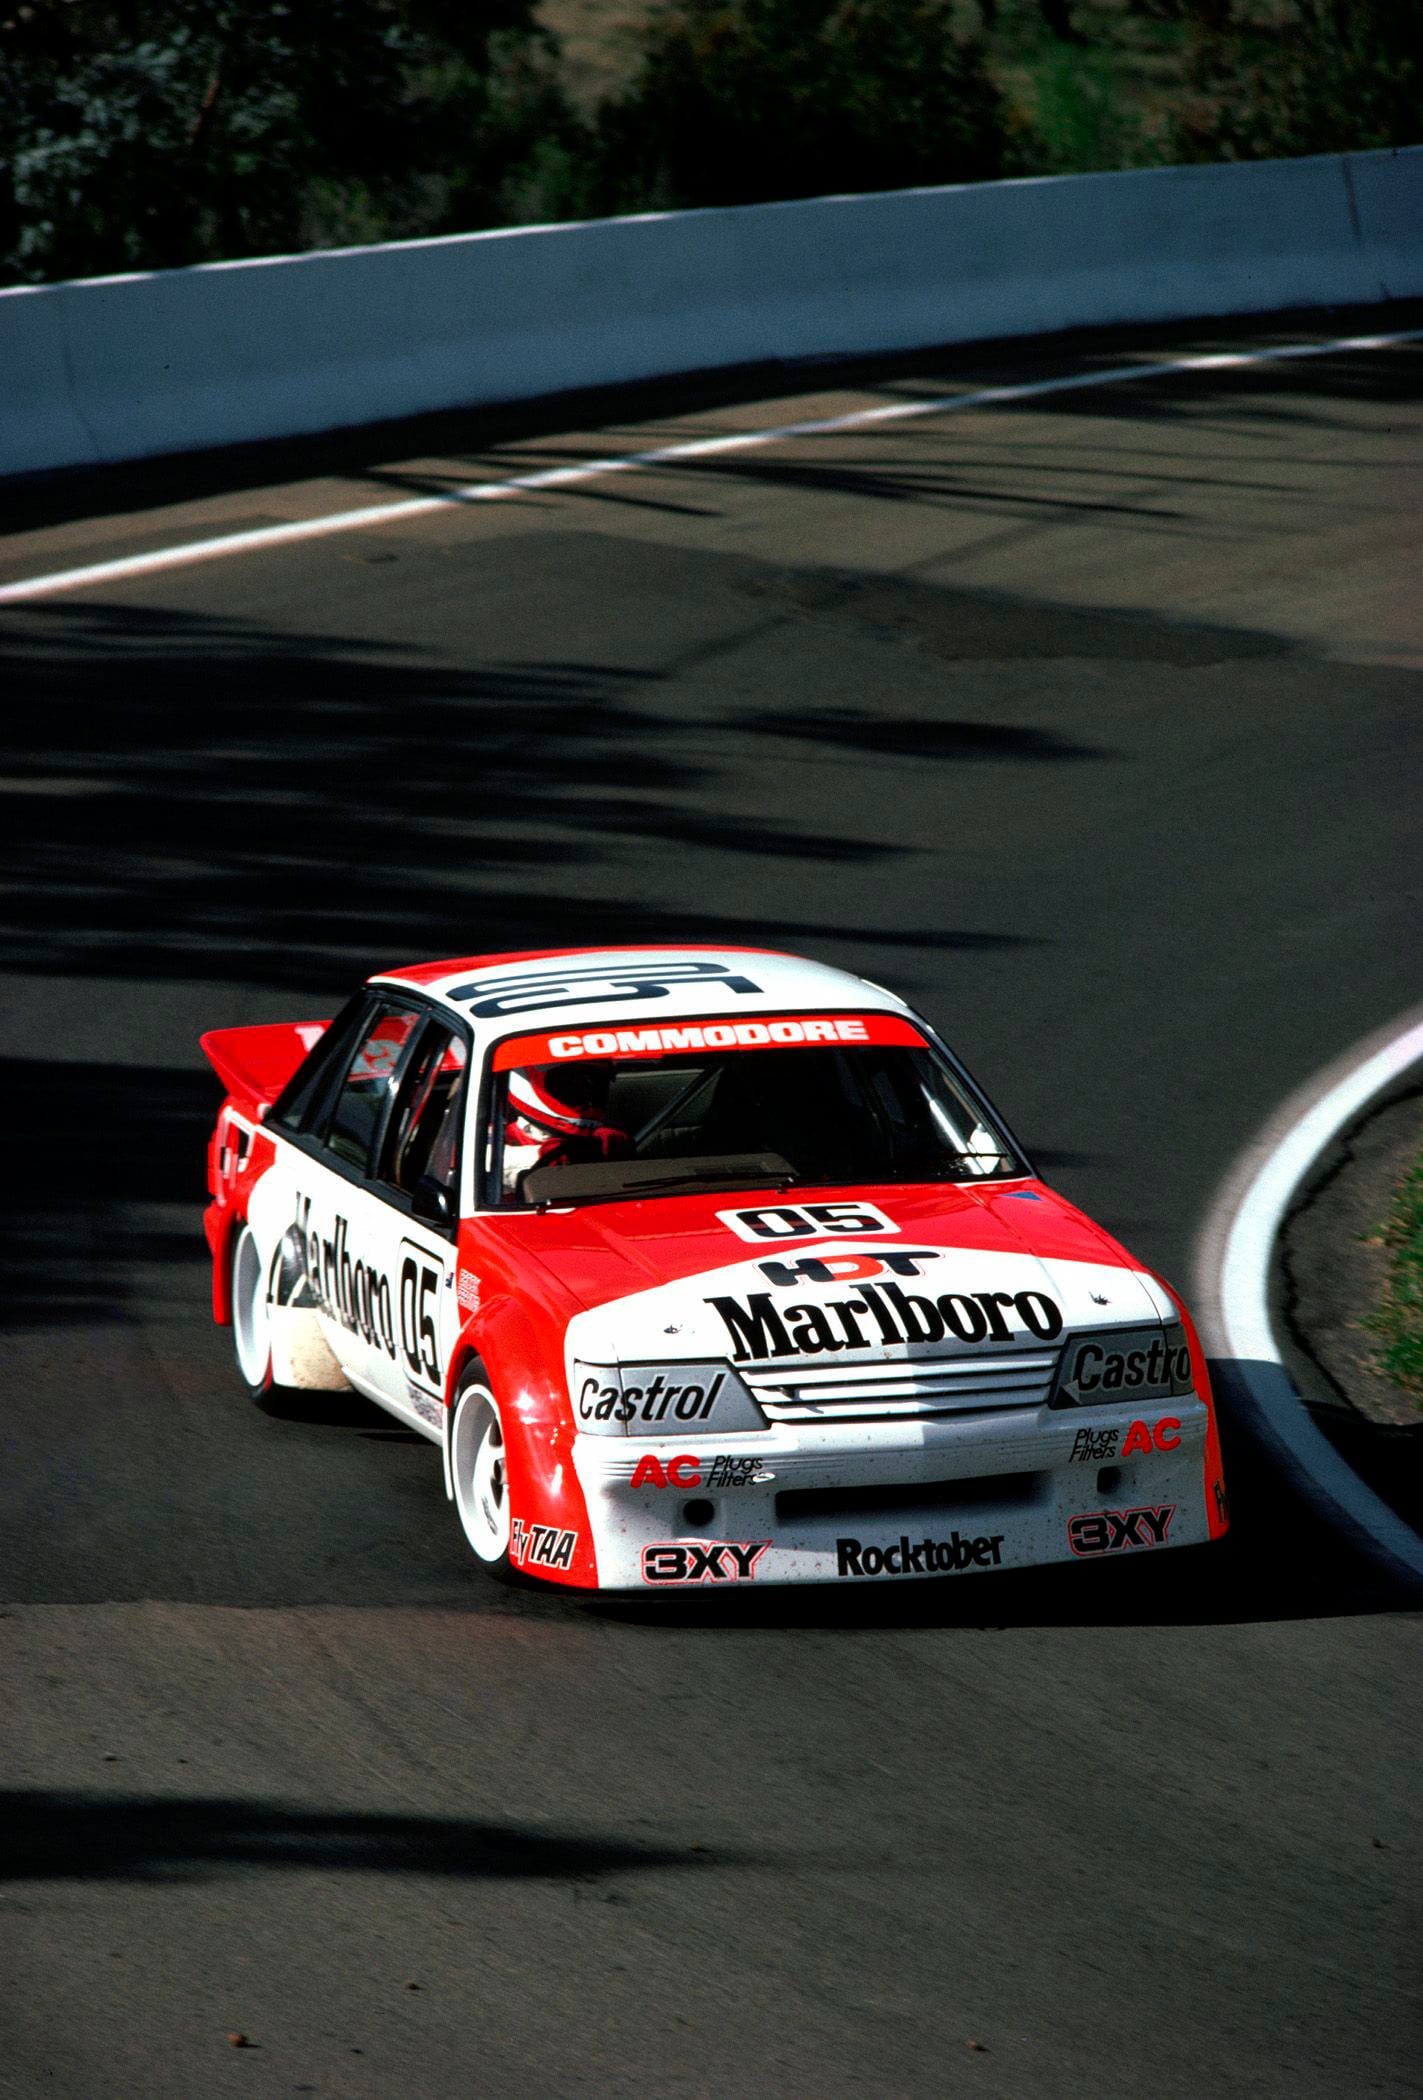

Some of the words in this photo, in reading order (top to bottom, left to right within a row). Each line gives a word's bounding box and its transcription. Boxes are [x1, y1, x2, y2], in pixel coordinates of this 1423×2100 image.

[548, 1020, 869, 1057] COMMODORE
[736, 1204, 885, 1238] 05
[757, 1251, 942, 1287] HDT
[401, 1256, 441, 1387] 05
[702, 1282, 1064, 1363] Marlboro
[579, 1373, 727, 1422] Castrol
[1069, 1443, 1117, 1462] Filters
[1074, 1427, 1120, 1448] Plugs
[1121, 1416, 1182, 1457] AC
[630, 1454, 702, 1489] AC
[711, 1454, 763, 1475] Plugs
[511, 1518, 530, 1566] Fly
[529, 1524, 578, 1570] TAA
[1070, 1506, 1174, 1554] 3XY
[643, 1541, 769, 1582] 3XY
[836, 1531, 1004, 1577] Rocktober
